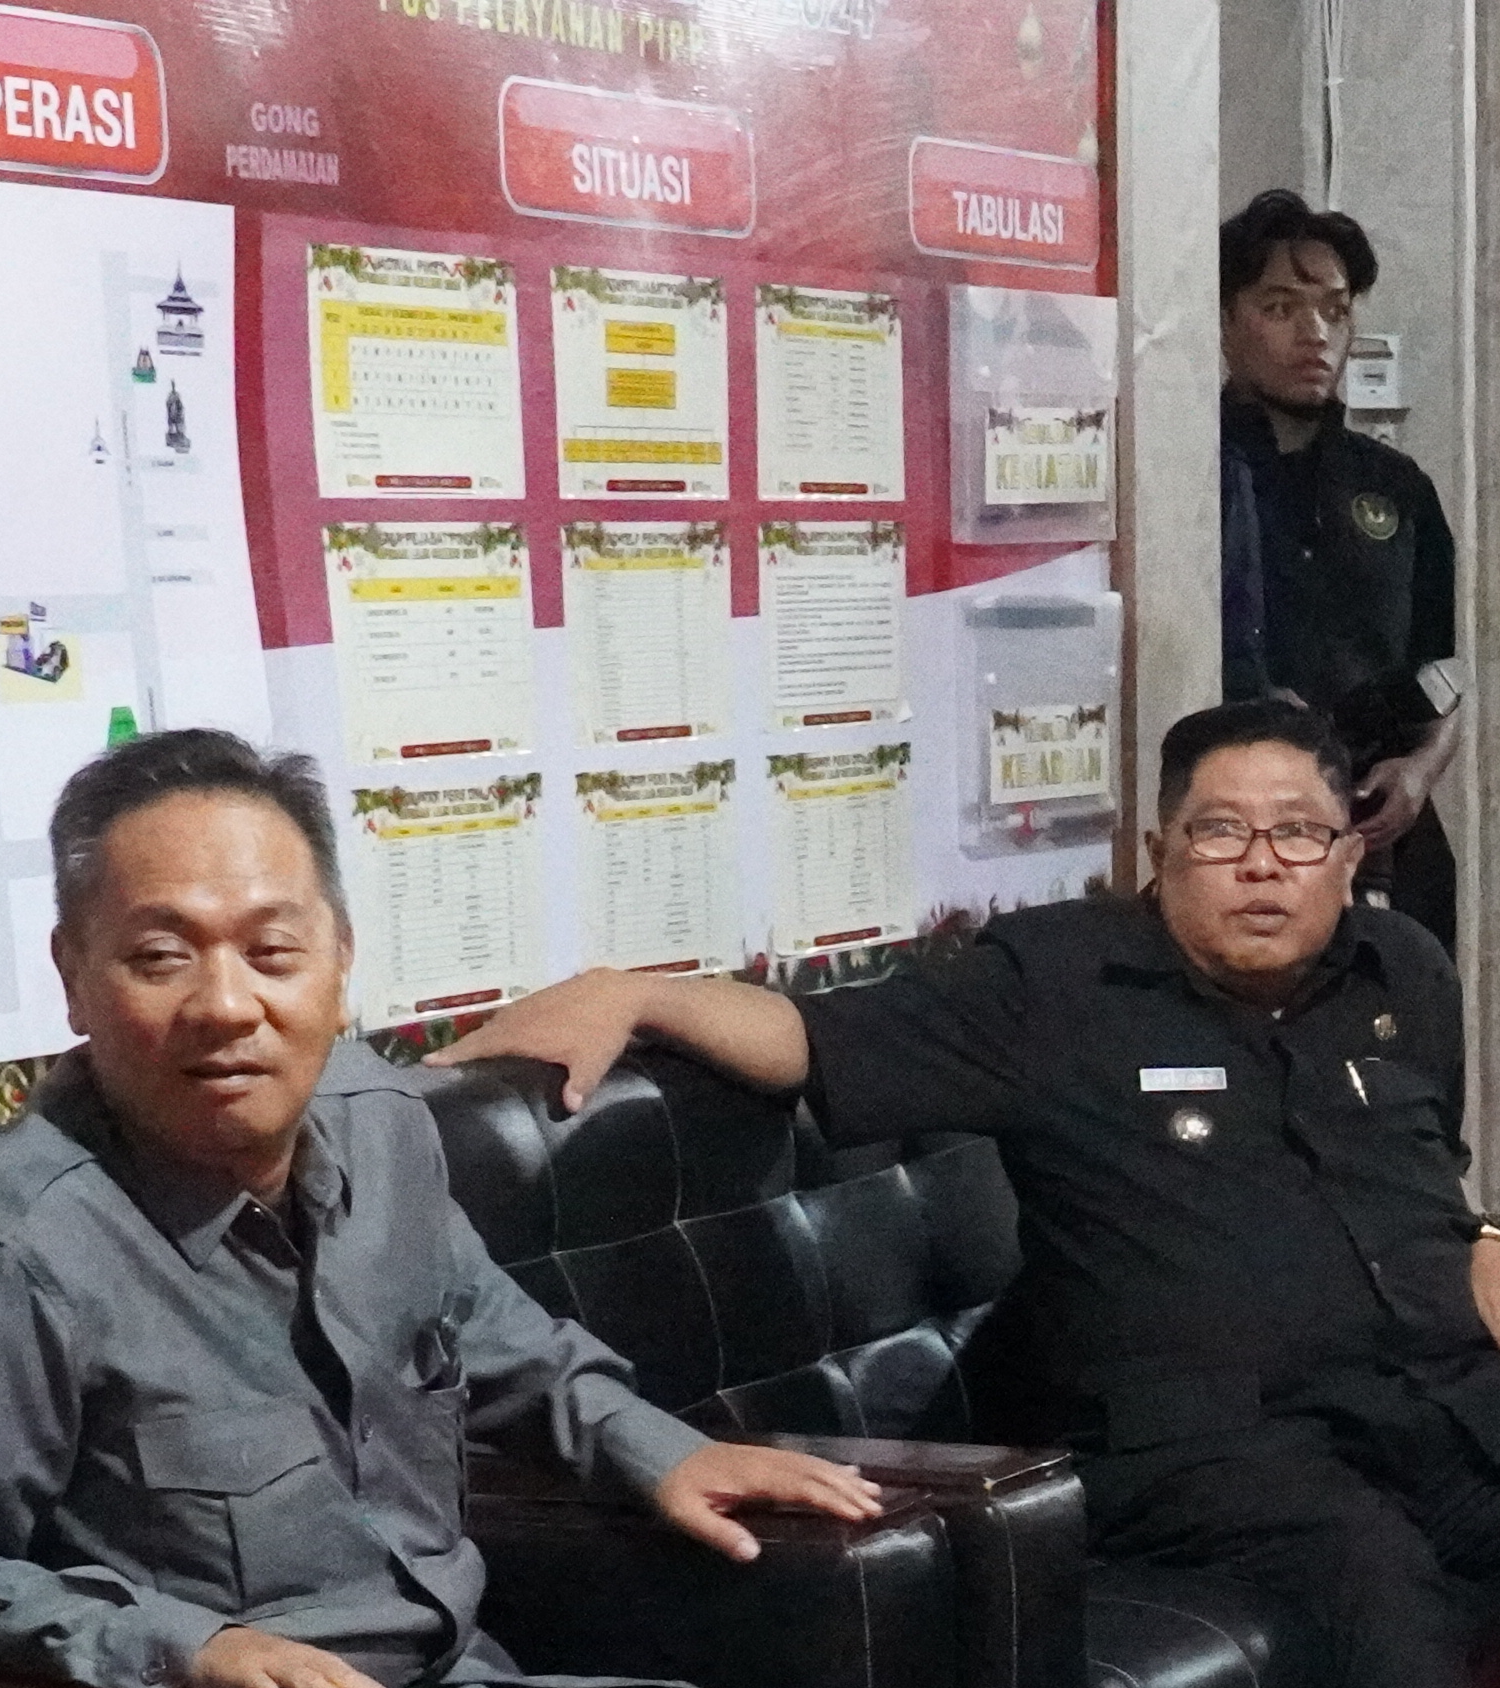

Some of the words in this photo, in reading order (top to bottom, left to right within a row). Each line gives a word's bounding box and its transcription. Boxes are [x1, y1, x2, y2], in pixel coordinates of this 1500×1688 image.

[250, 102, 320, 138] GONG
[572, 143, 691, 205] SITUASI
[953, 191, 1063, 245] TABULASI
